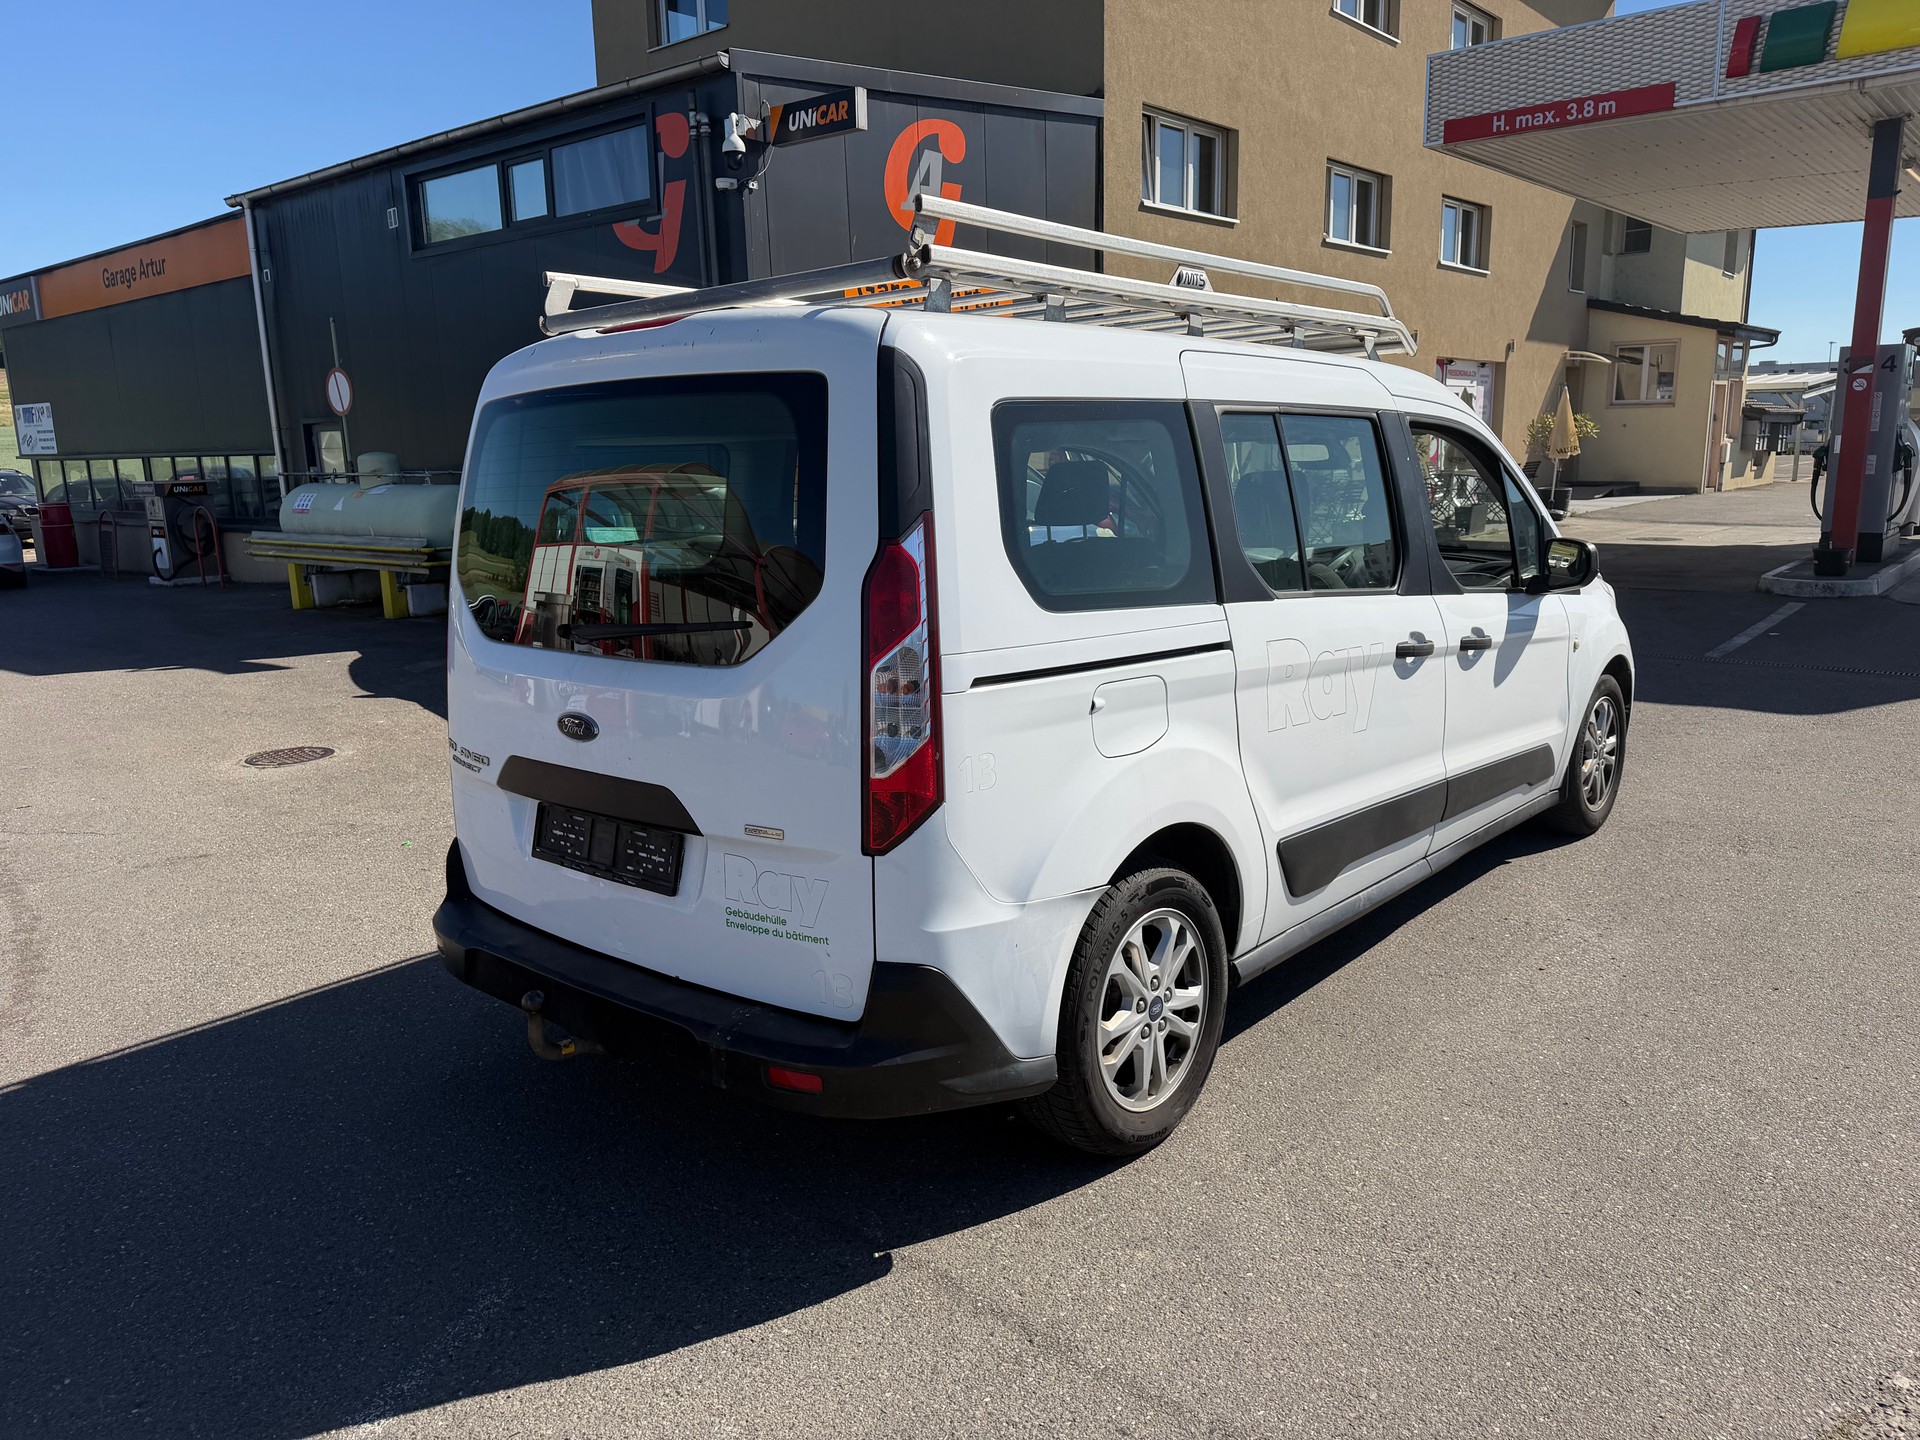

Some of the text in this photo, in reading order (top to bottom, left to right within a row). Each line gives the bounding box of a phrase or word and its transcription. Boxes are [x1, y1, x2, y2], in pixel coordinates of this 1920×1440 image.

[1492, 99, 1616, 132] H. max. 3.8 m
[102, 258, 166, 289] Garage Artur
[1880, 354, 1897, 373] 4
[1265, 637, 1384, 734] Ray
[561, 717, 585, 736] Ford
[958, 752, 998, 794] 13
[723, 852, 830, 929] Ray
[725, 906, 787, 926] Gebäudehülle
[725, 918, 830, 946] Enveloppe du bâtiment
[1086, 909, 1129, 1003] POLARIS 5
[811, 969, 854, 1009] 13
